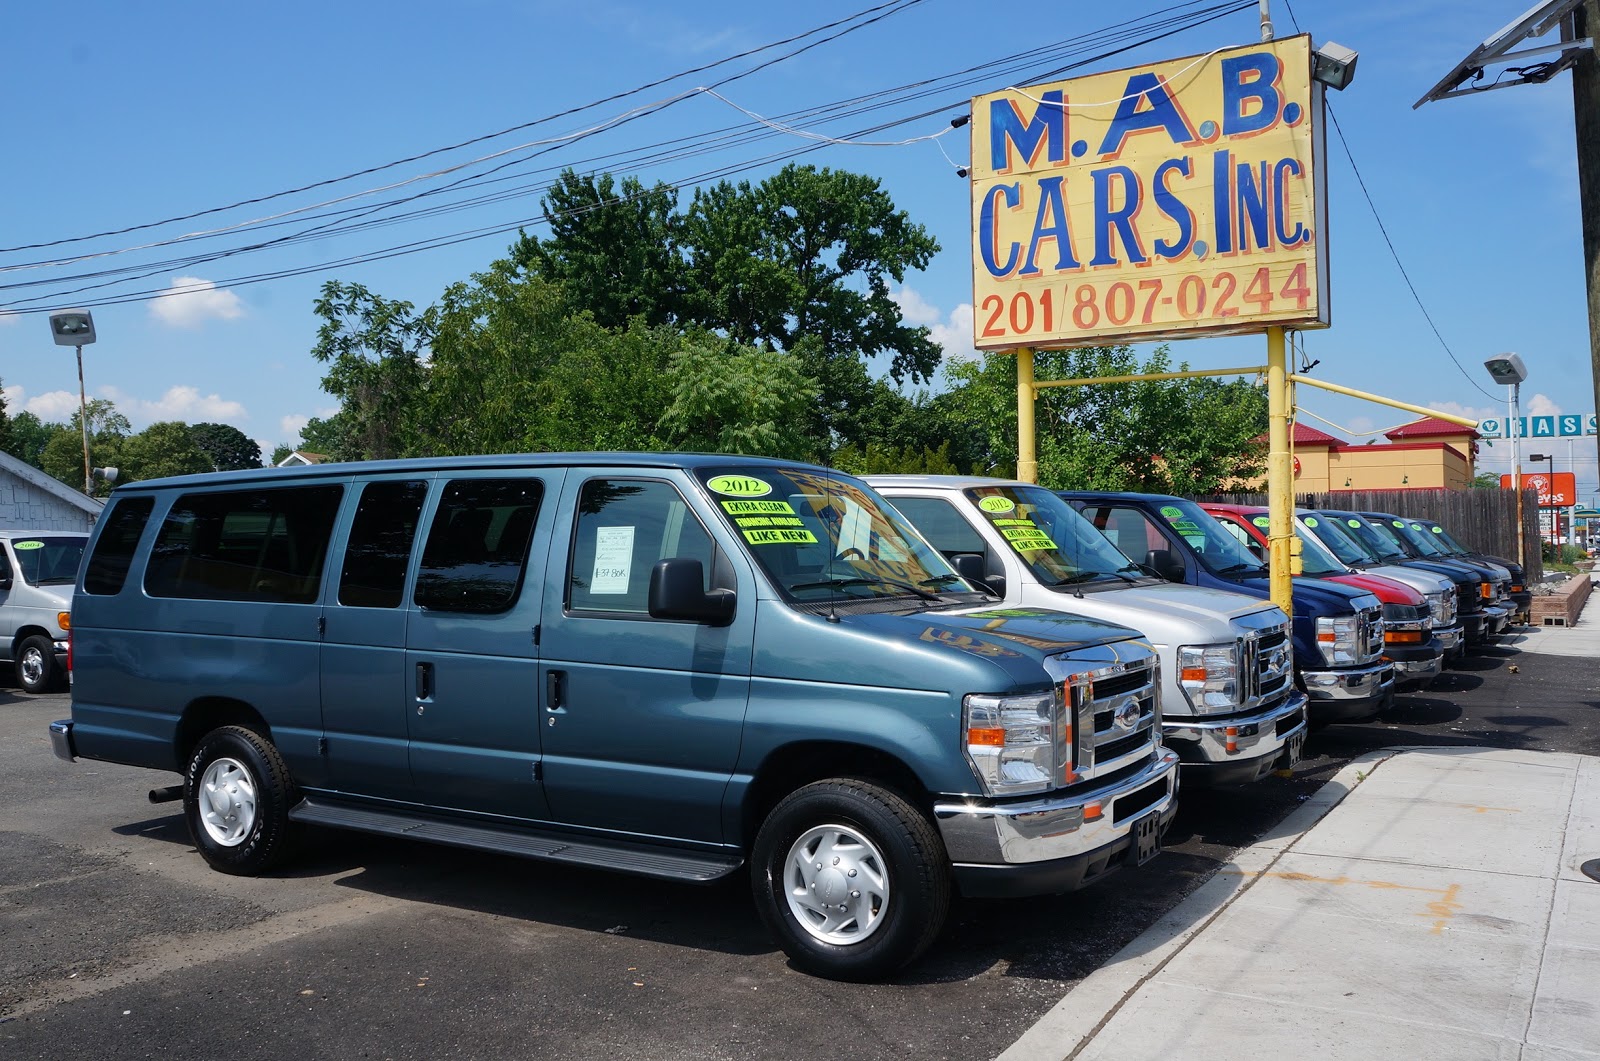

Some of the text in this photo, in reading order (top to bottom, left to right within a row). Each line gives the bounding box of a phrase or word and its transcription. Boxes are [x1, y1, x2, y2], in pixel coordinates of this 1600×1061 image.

[990, 52, 1303, 174] M.A.B.
[721, 480, 761, 491] 2012
[727, 501, 787, 512] EXTRA CLEAN
[986, 499, 1009, 510] 2012
[750, 531, 809, 542] LIKE NEW
[1016, 540, 1053, 550] LIKE NEW
